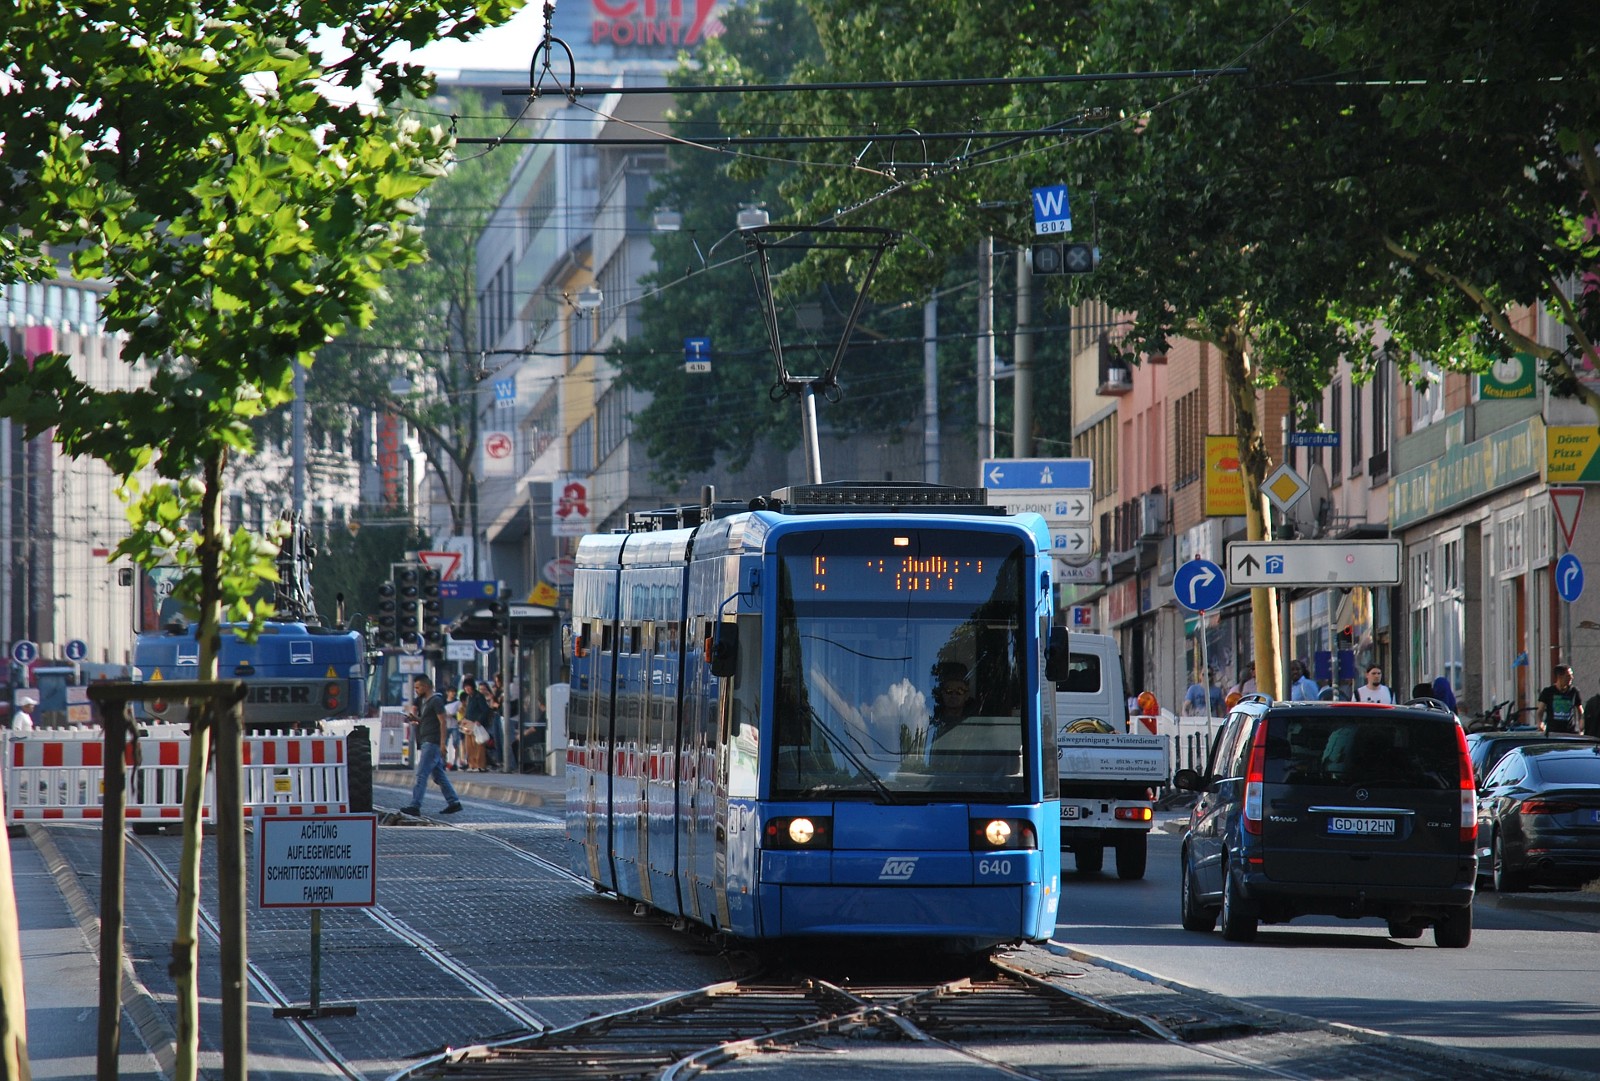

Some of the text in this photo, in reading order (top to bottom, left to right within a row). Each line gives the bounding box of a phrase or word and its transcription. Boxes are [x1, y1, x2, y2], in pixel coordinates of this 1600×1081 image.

[592, 20, 682, 46] POINT
[1036, 190, 1064, 216] W
[1041, 221, 1065, 233] 802
[691, 341, 704, 359] T
[496, 381, 512, 397] W
[1483, 384, 1533, 398] Restaurant
[1290, 433, 1338, 446] Jägerstraße
[1557, 434, 1590, 445] Döner
[1553, 449, 1582, 459] Pizza
[1548, 462, 1576, 473] Salat
[1007, 503, 1052, 513] ITY-POINT
[1057, 736, 1158, 745] ußwegreinigung Winterdienst
[1270, 815, 1297, 823] VIANO
[1335, 819, 1352, 830] GD
[1356, 819, 1393, 832] 012HN
[301, 824, 338, 839] ACHTUNG
[287, 844, 351, 860] AUFLEGEWEICHE
[267, 865, 369, 880] SCHRITTGESCHWINDIGKEIT
[881, 861, 916, 875] KVG
[979, 860, 1011, 875] 640
[303, 886, 334, 900] FAHREN
